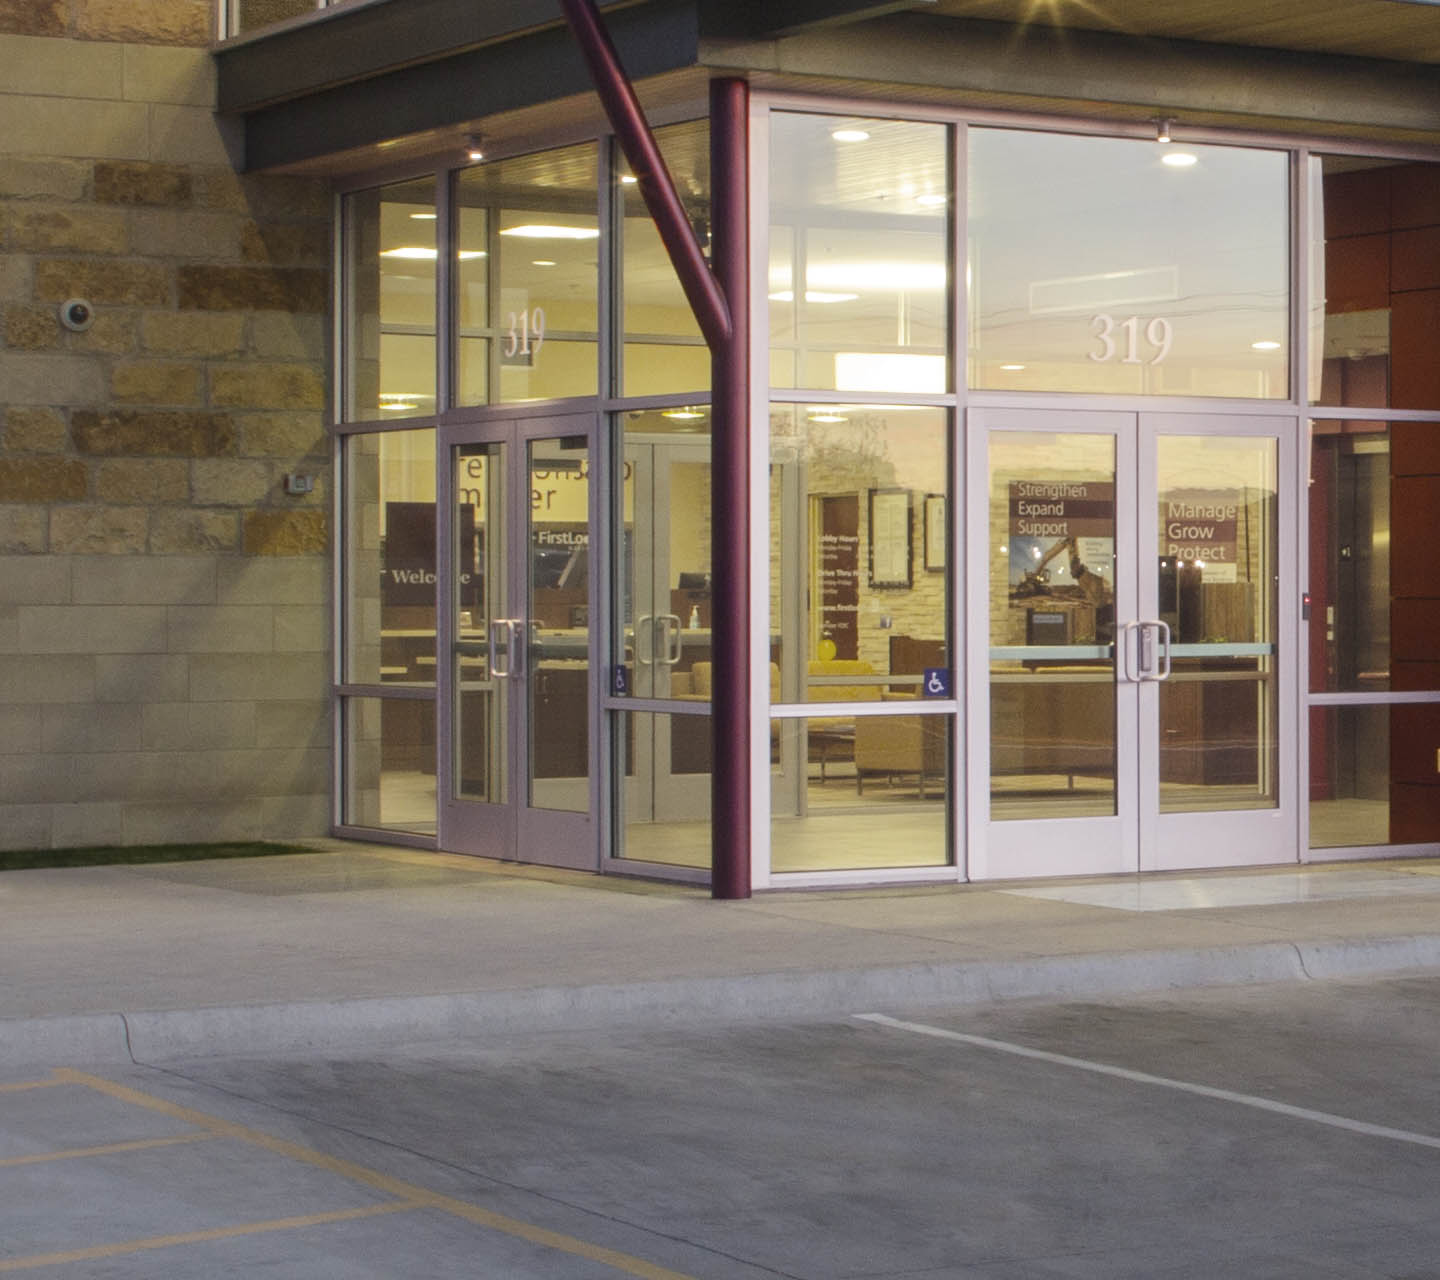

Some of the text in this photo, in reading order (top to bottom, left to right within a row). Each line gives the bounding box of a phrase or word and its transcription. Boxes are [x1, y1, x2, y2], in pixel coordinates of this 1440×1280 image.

[505, 307, 545, 357] 319
[1087, 313, 1173, 365] 319
[1017, 482, 1088, 500] Strengthen
[1018, 501, 1065, 519] Expand
[1168, 502, 1237, 522] Manage
[1018, 520, 1069, 538] Support
[1167, 523, 1215, 540] Grow
[1167, 543, 1226, 560] Protect
[391, 568, 471, 585] Welce
